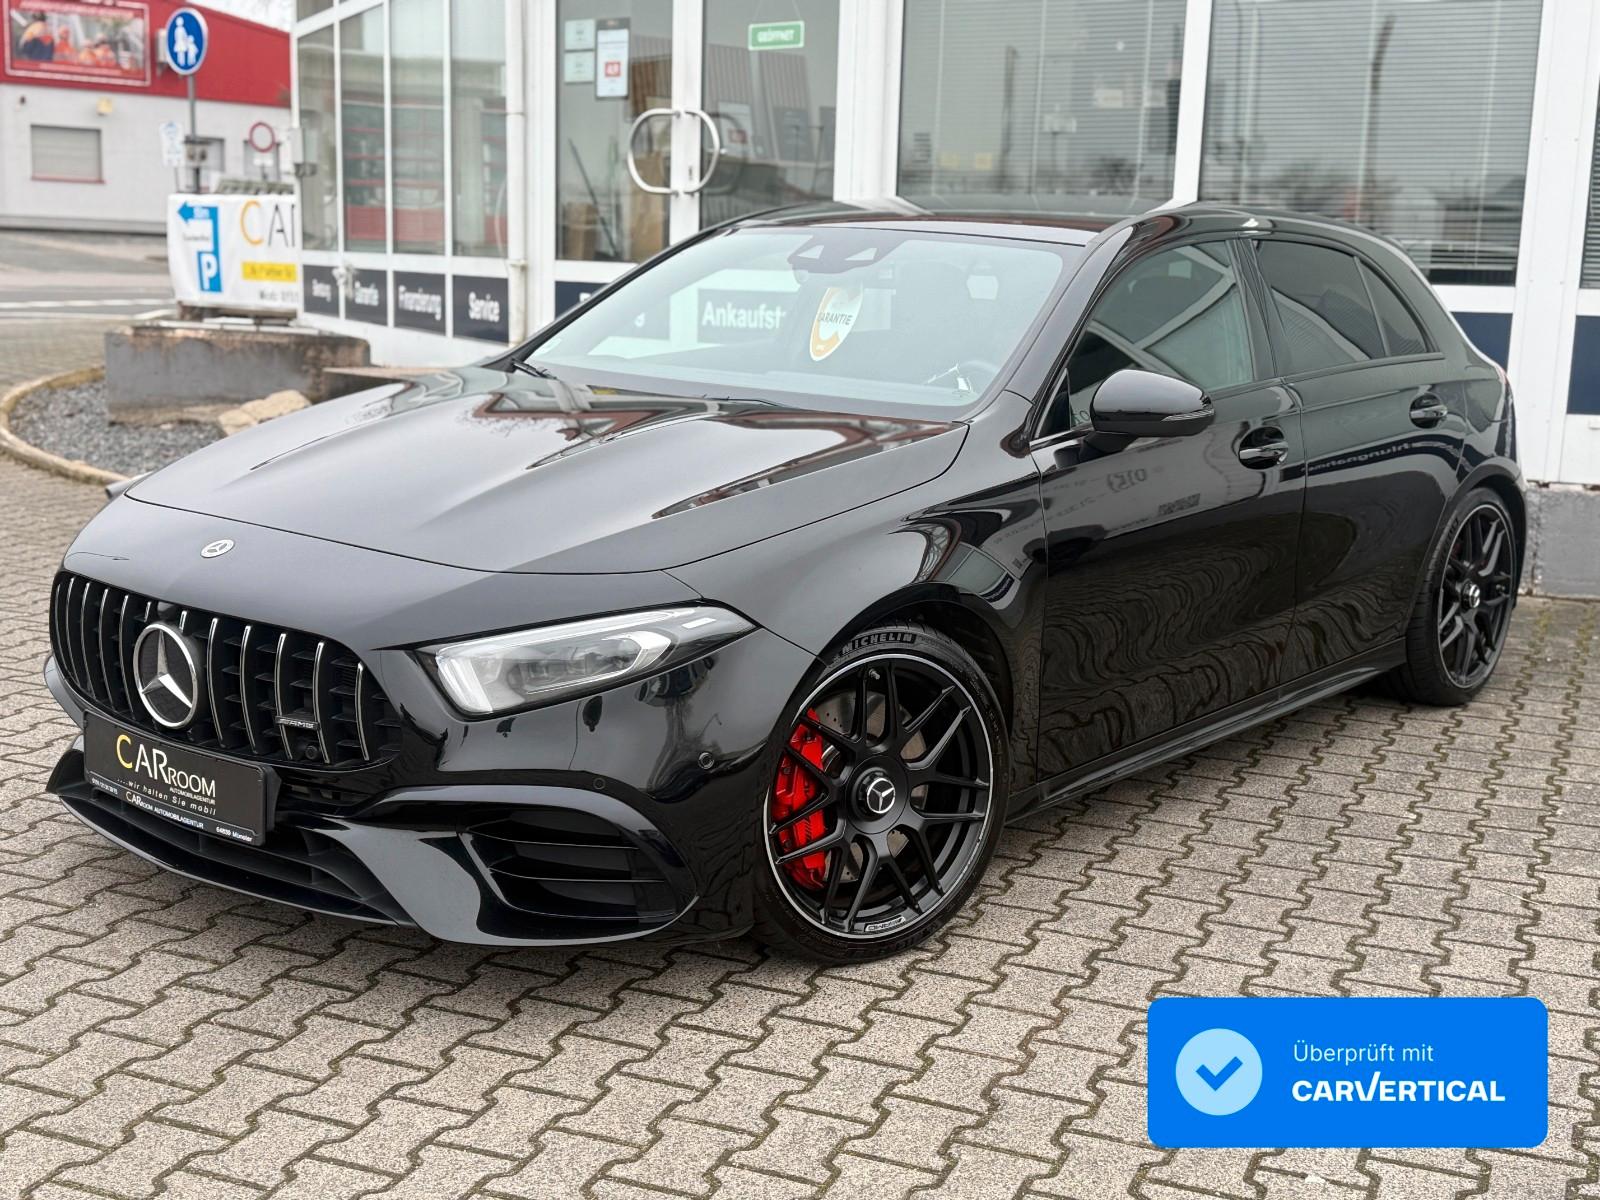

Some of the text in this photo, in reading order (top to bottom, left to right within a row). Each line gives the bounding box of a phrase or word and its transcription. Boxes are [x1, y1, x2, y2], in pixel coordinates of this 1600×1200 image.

[469, 292, 499, 322] Service
[842, 632, 913, 654] MICHELIN
[143, 785, 168, 801] halten
[172, 796, 186, 807] Sie
[190, 803, 216, 816] mobil
[169, 787, 216, 806] AUTOMOBILAGENTUR
[154, 806, 204, 829] AUTOMOBILAGENTUR
